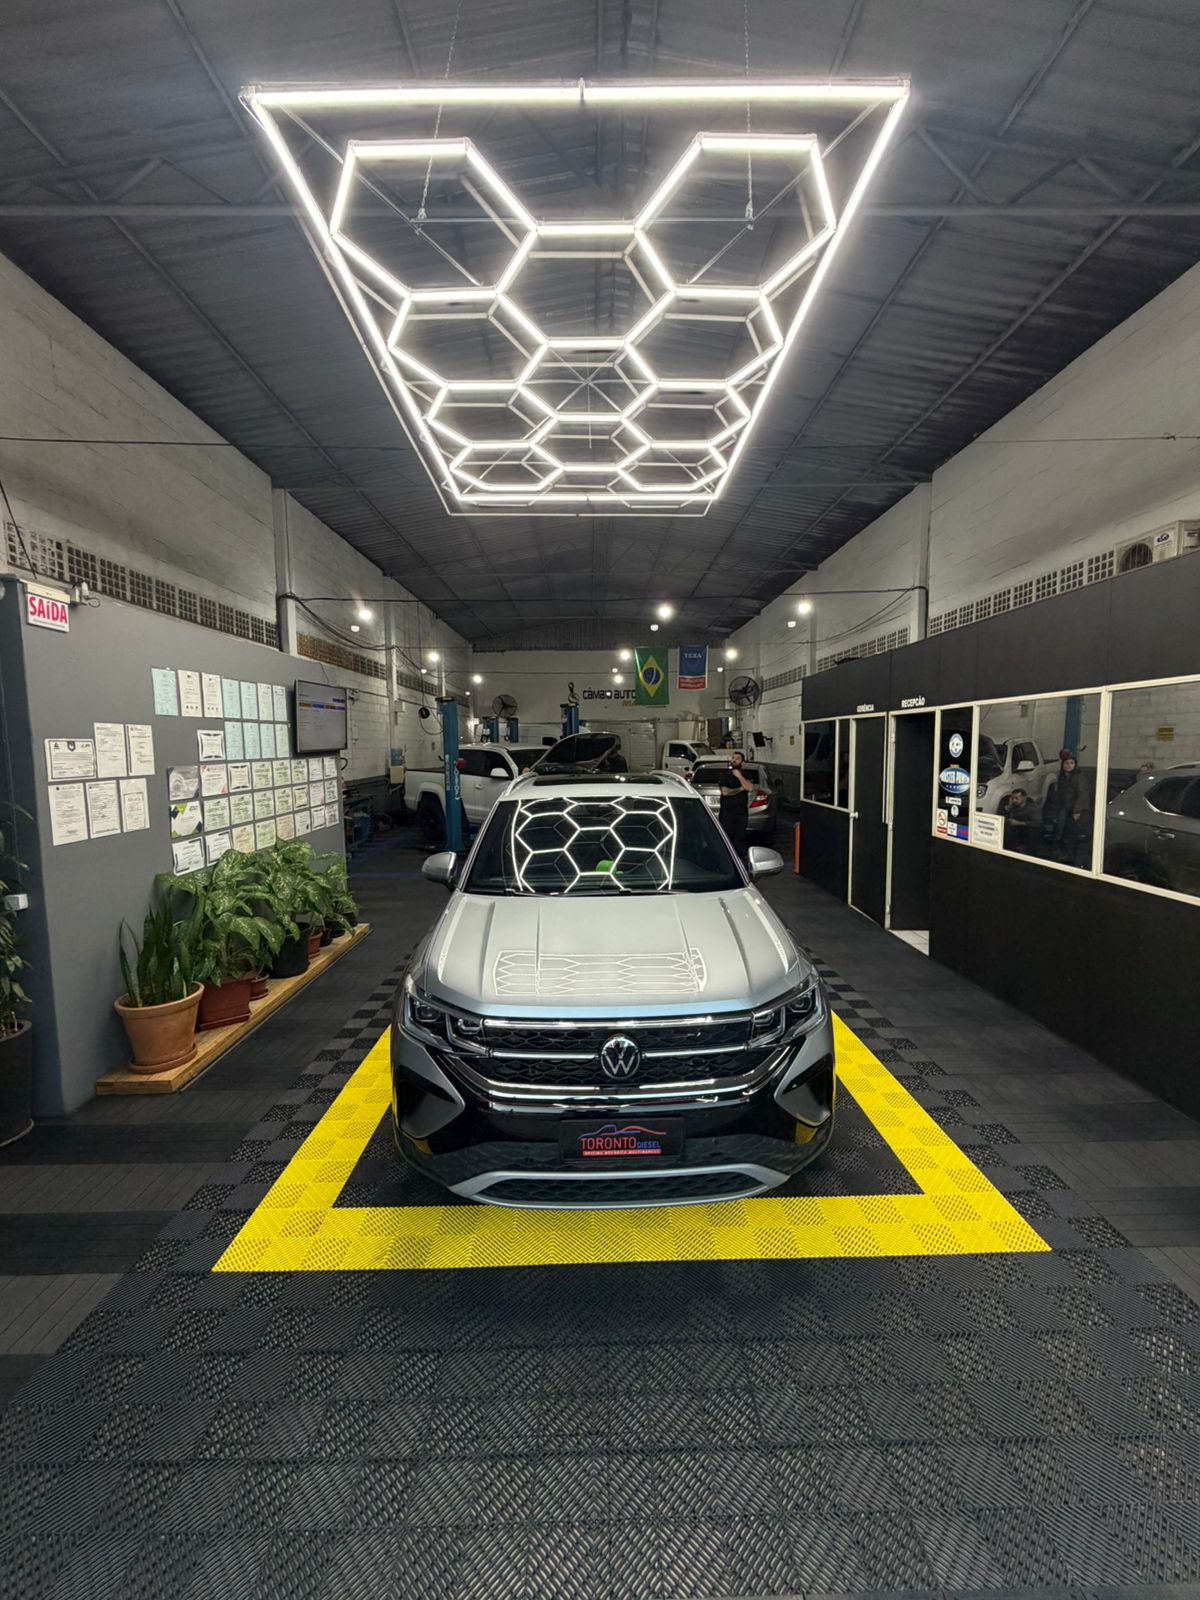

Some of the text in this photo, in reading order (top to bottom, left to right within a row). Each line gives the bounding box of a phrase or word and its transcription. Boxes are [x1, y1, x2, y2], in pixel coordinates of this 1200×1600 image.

[901, 696, 925, 708] RECEPÇÃO
[581, 1137, 660, 1150] TORONTO DIESEL
